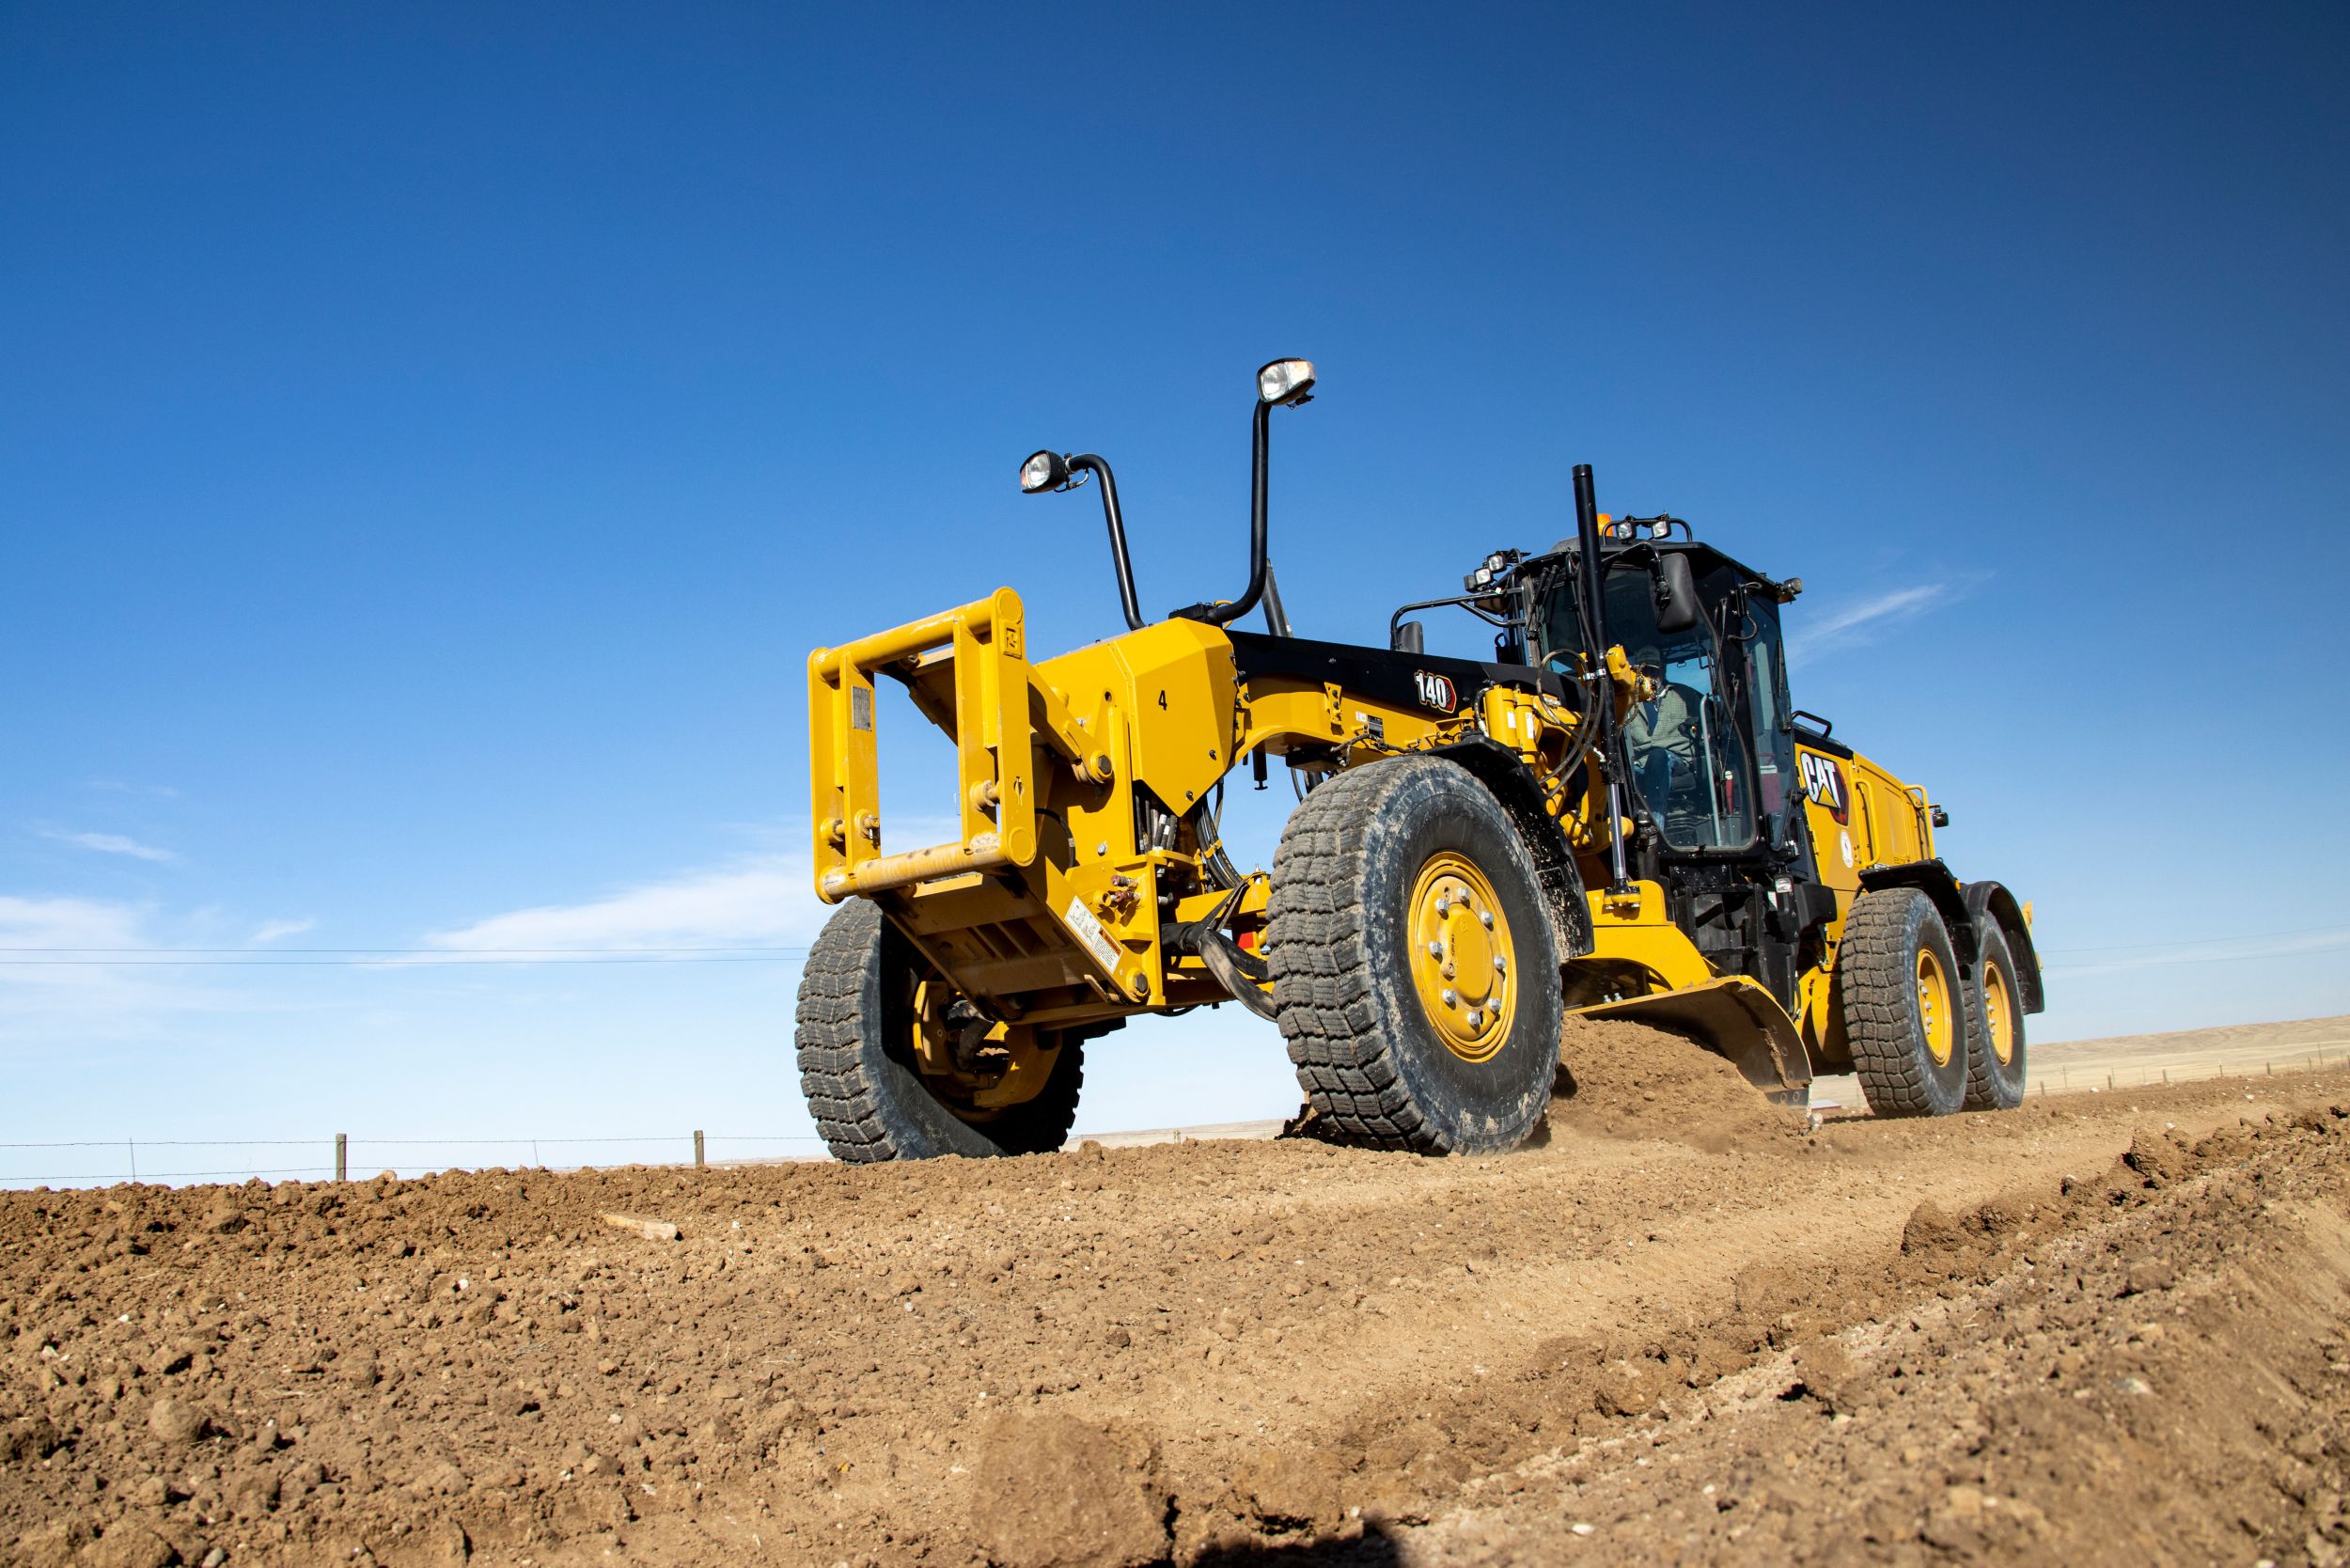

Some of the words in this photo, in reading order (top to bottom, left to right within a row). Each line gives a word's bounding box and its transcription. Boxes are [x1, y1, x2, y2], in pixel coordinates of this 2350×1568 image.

[1158, 689, 1167, 711] 4
[1416, 672, 1447, 708] 140
[1801, 752, 1841, 808] CAT
